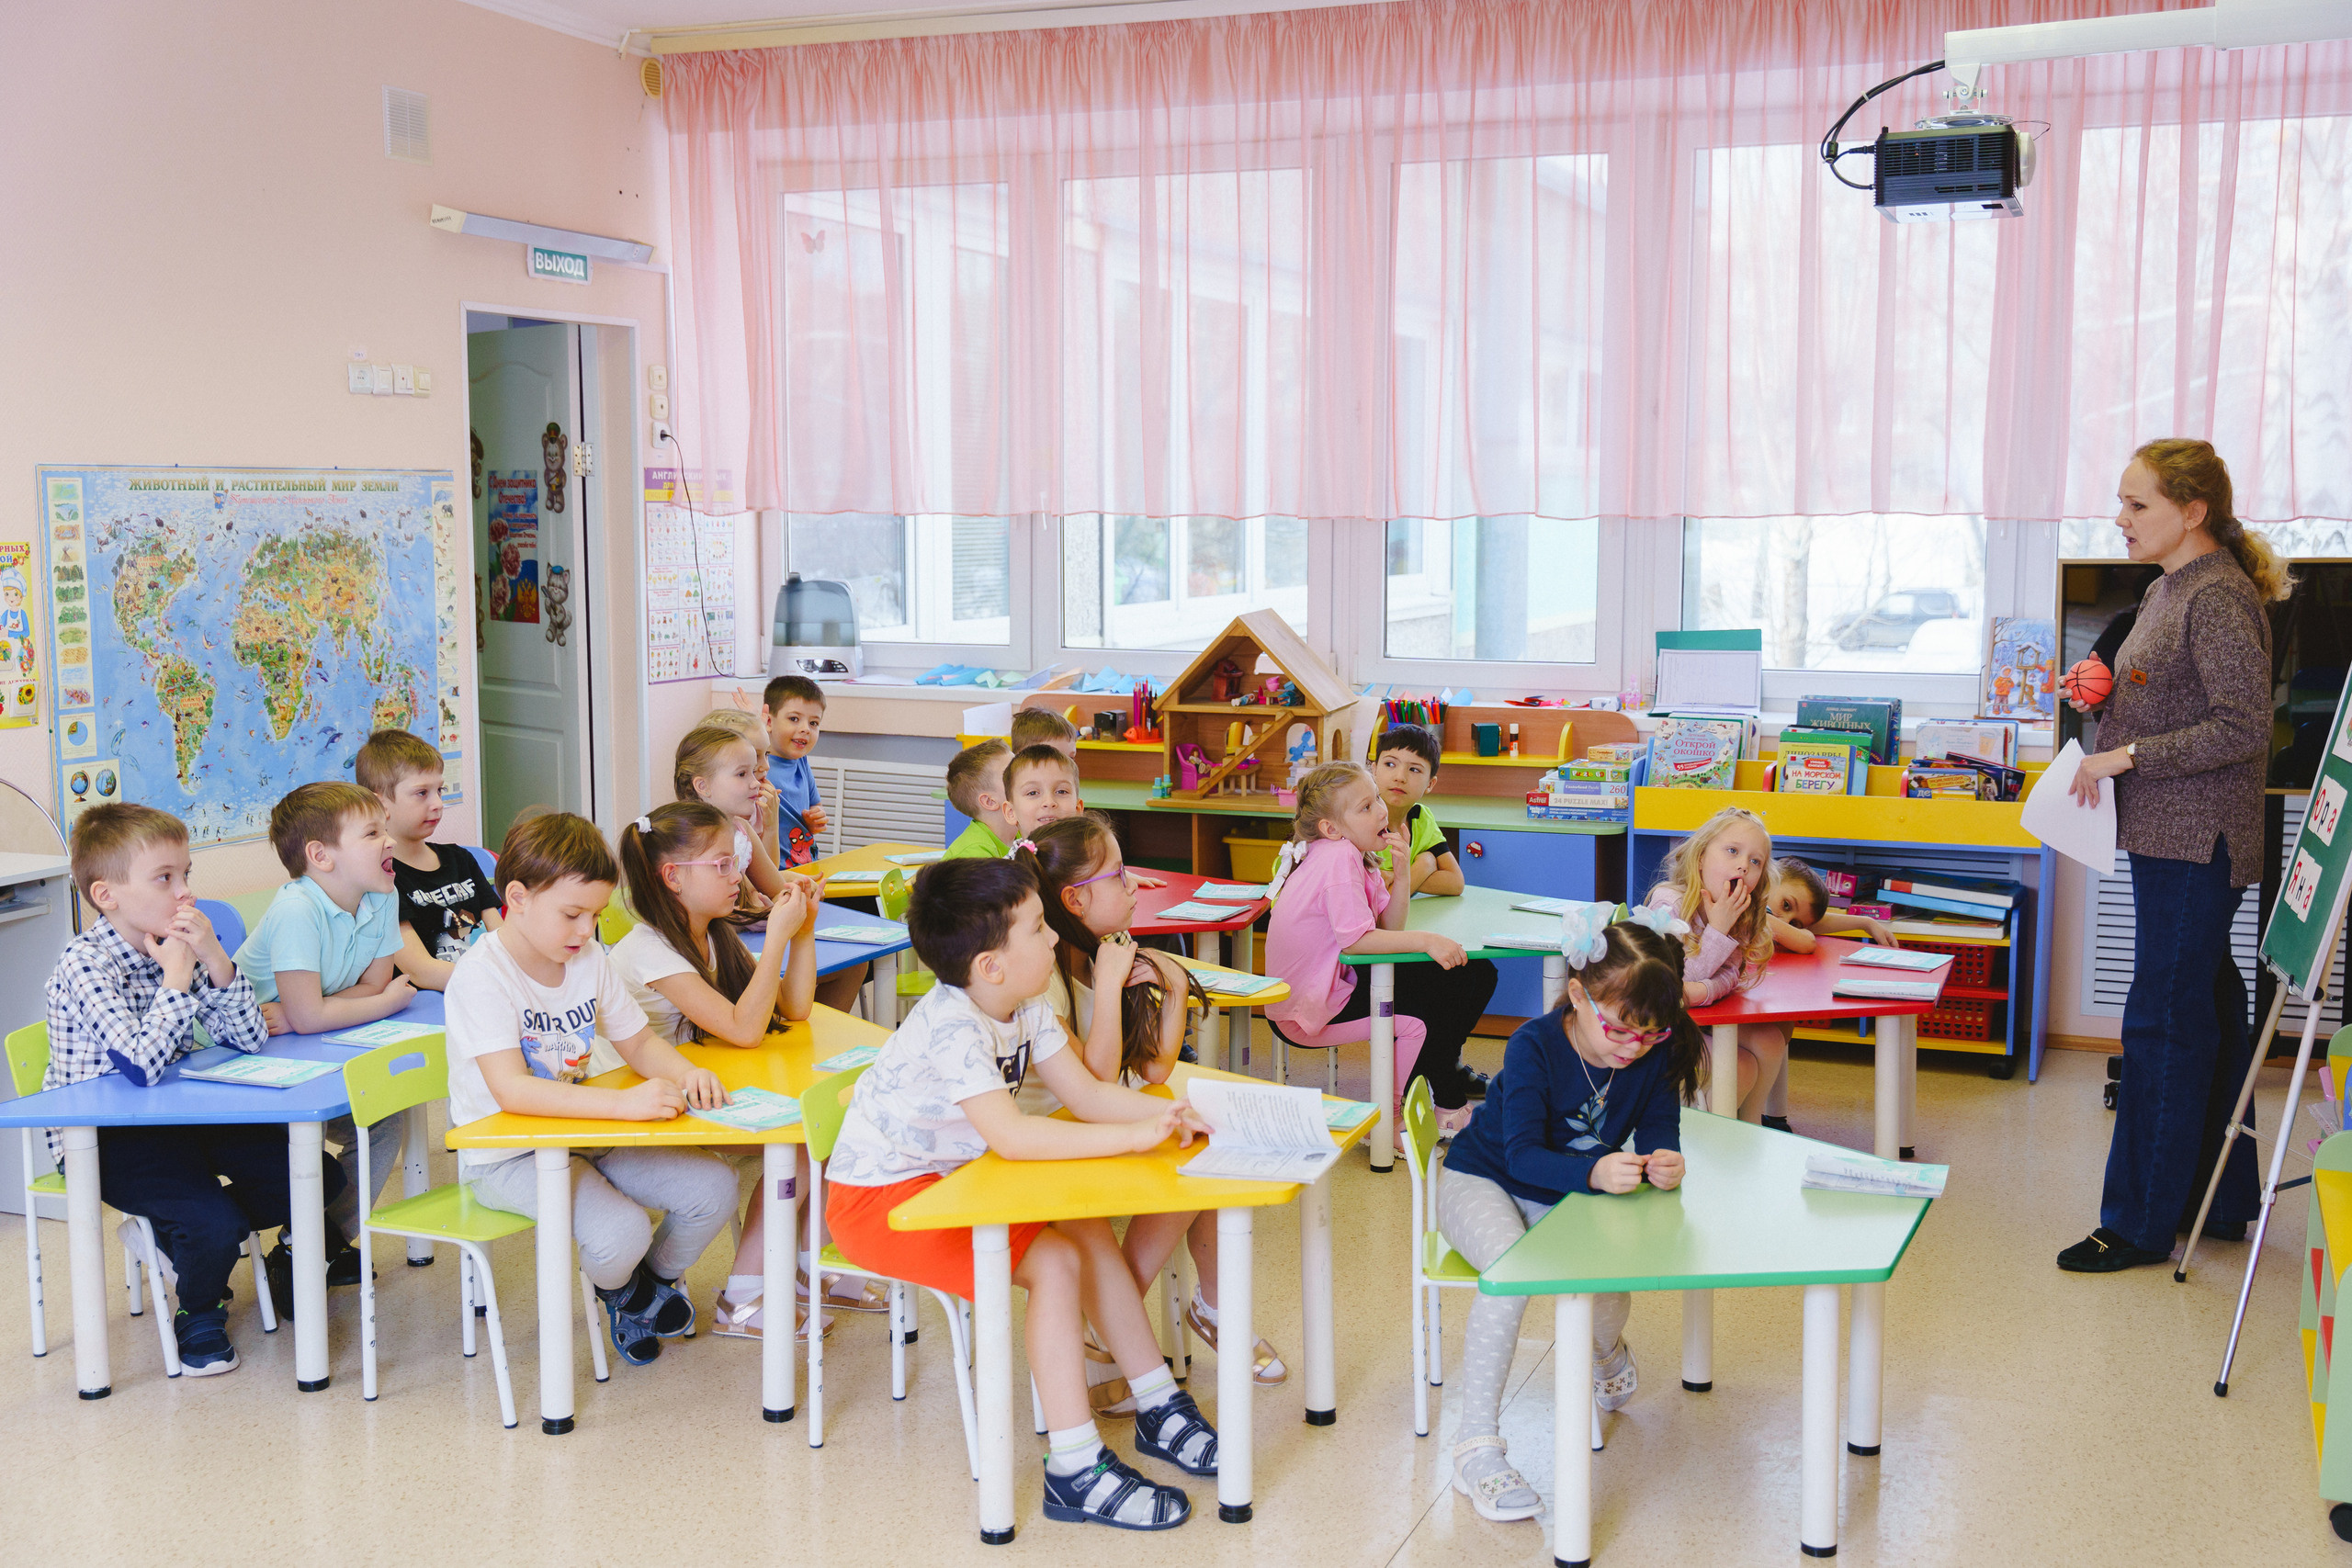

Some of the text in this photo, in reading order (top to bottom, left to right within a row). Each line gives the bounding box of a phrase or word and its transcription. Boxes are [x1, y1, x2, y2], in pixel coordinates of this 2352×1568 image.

[535, 251, 585, 277] ВЫХОД
[129, 476, 399, 492] ЖИВОТНЫЙ И РАСТИТЕЛЬНЫЙ МИР ЗЕМЛИ
[1829, 712, 1852, 722] МИР
[1810, 719, 1871, 730] ЖИВОТНЫХ
[1675, 739, 1716, 750] Открой
[1673, 749, 1715, 757] окошко
[1804, 771, 1841, 779] МОРСКОМ
[1609, 785, 1626, 794] 260
[1795, 779, 1835, 790] БЕРЕГУ
[2311, 784, 2337, 834] Юра
[2288, 861, 2313, 909] Яна
